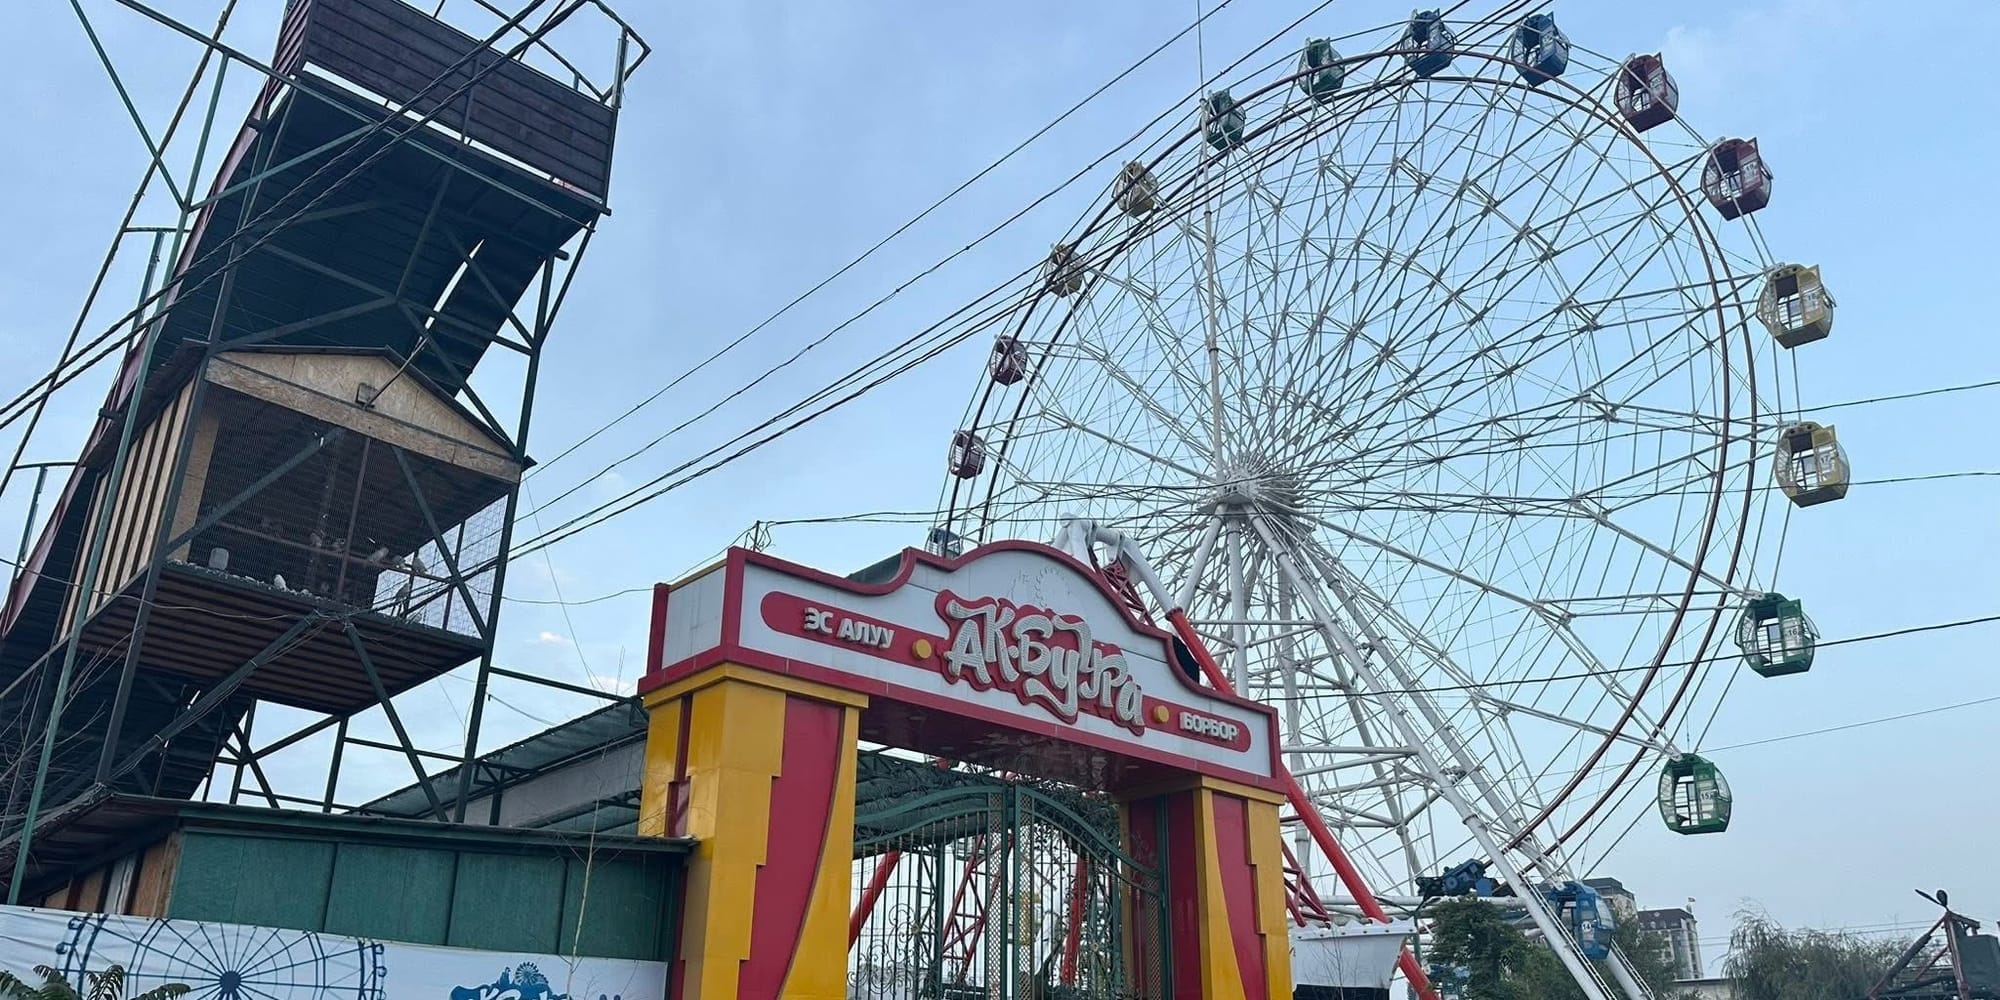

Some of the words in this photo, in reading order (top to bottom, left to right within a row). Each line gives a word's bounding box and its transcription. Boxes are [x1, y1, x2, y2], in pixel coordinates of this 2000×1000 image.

[804, 607, 833, 634] ЭС
[837, 618, 895, 648] АЛУУ
[1180, 712, 1237, 740] БОРБОР
